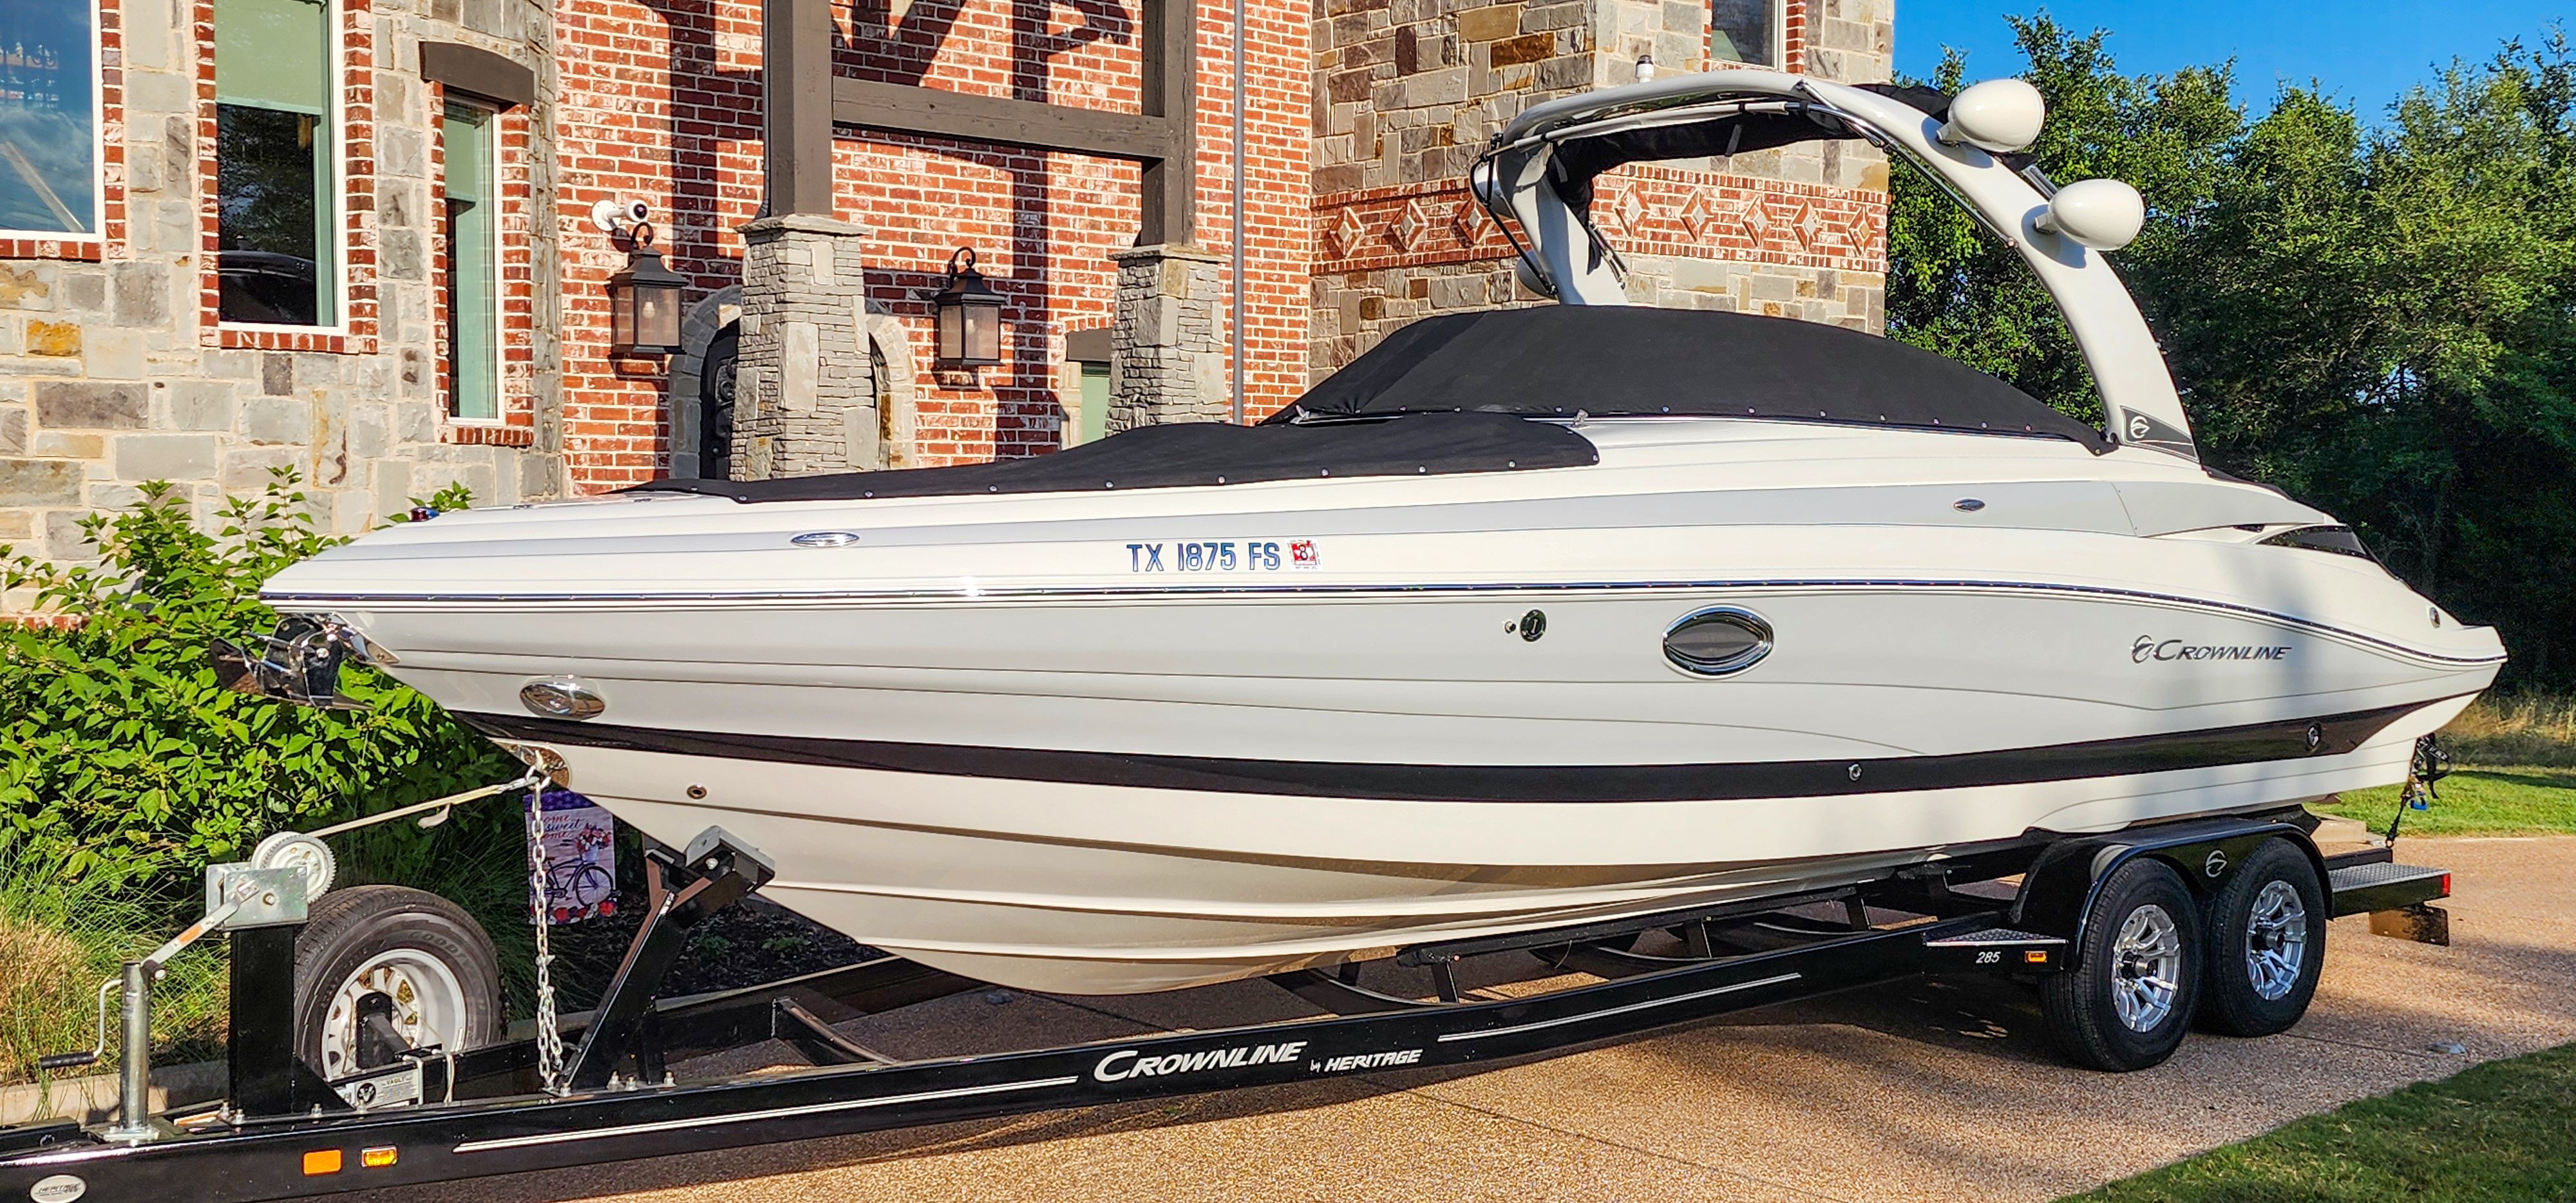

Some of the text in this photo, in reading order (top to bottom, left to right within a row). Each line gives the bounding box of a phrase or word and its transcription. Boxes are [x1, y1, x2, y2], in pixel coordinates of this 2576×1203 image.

[1126, 542, 1280, 572] TX 1875 FS
[2153, 639, 2292, 661] CROWNLINE
[1975, 951, 2002, 964] 285
[1094, 1041, 1423, 1082] CROWNLINE by HERITAGE
